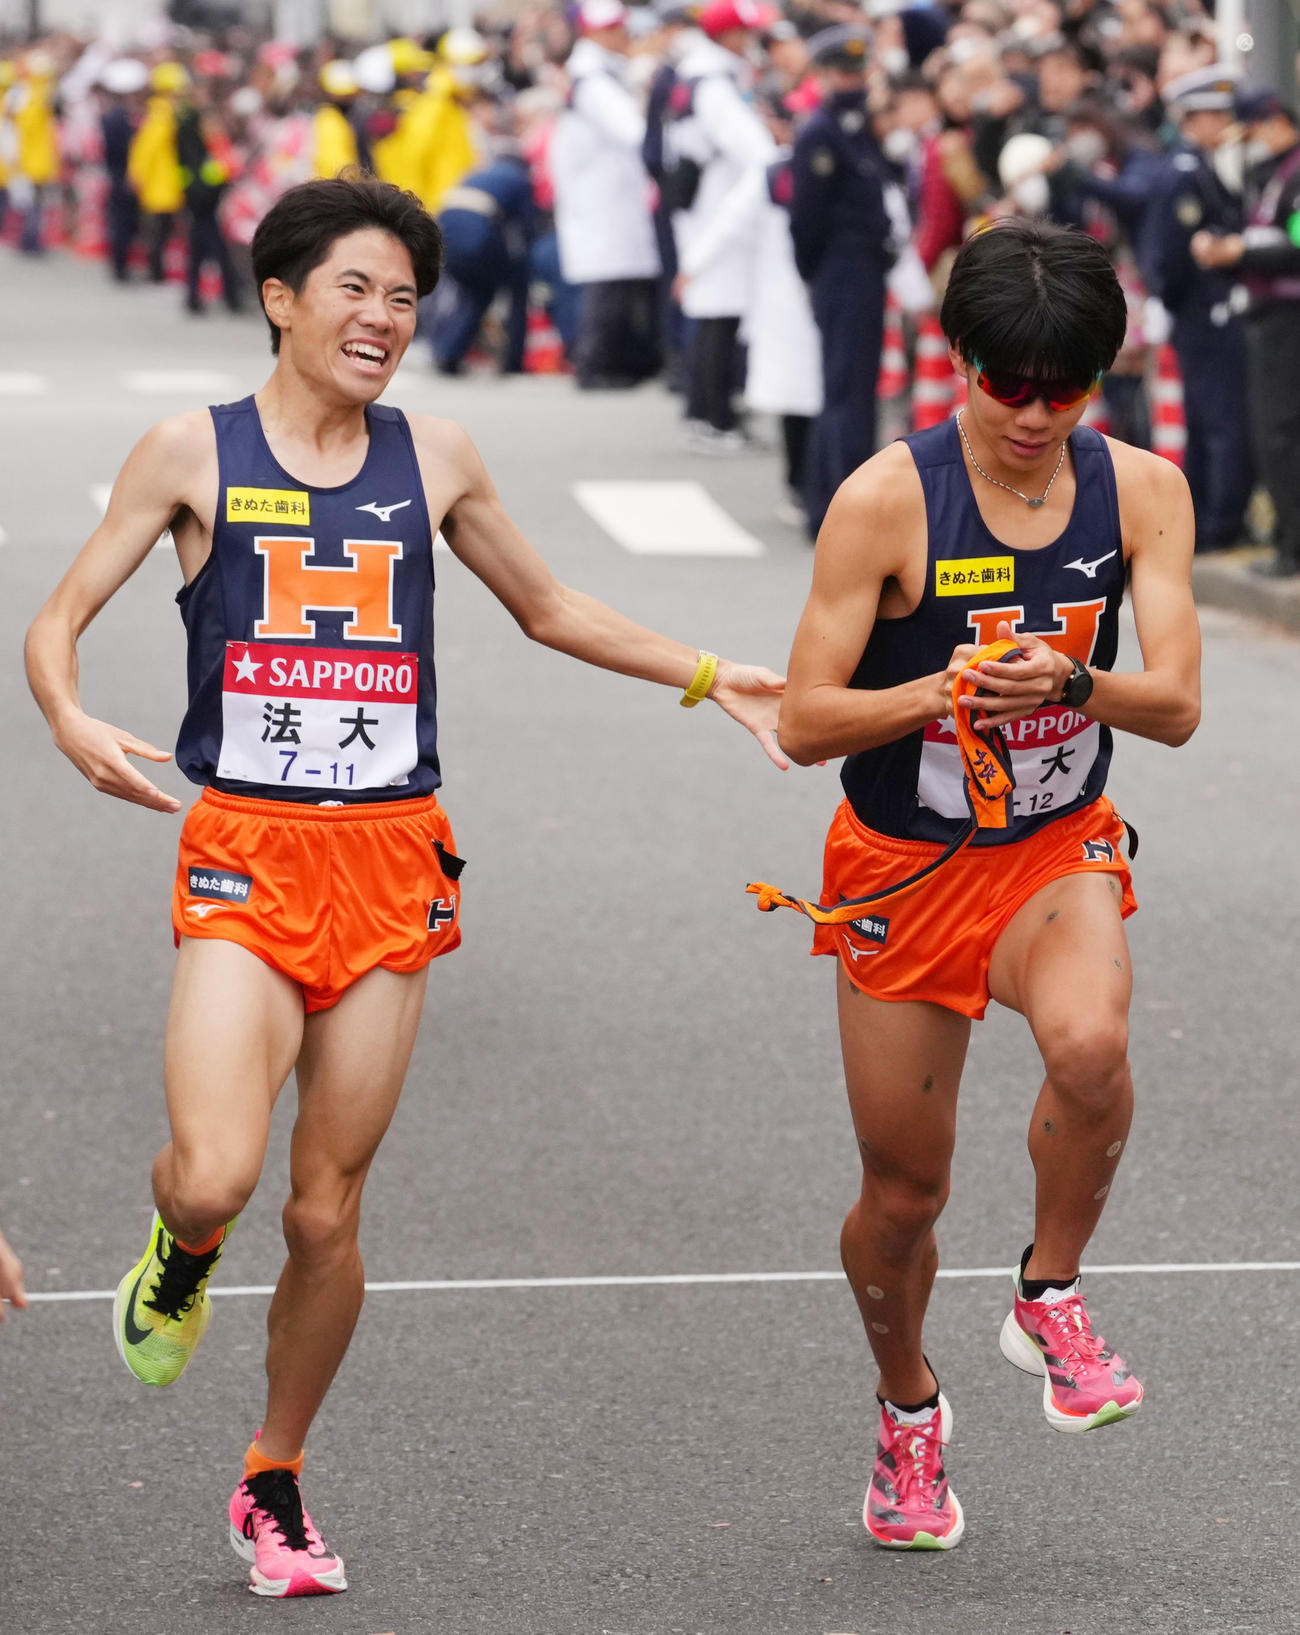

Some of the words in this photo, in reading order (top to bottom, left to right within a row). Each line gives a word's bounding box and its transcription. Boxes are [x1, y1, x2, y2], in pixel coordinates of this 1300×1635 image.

[230, 497, 306, 515] きぬた歯科
[254, 536, 403, 643] H
[939, 566, 1010, 586] きぬた歯科
[269, 657, 412, 693] SAPPORO
[279, 750, 354, 786] 7-11
[1039, 745, 1075, 784] 大
[190, 874, 248, 897] きぬた歯科
[427, 894, 456, 932] H
